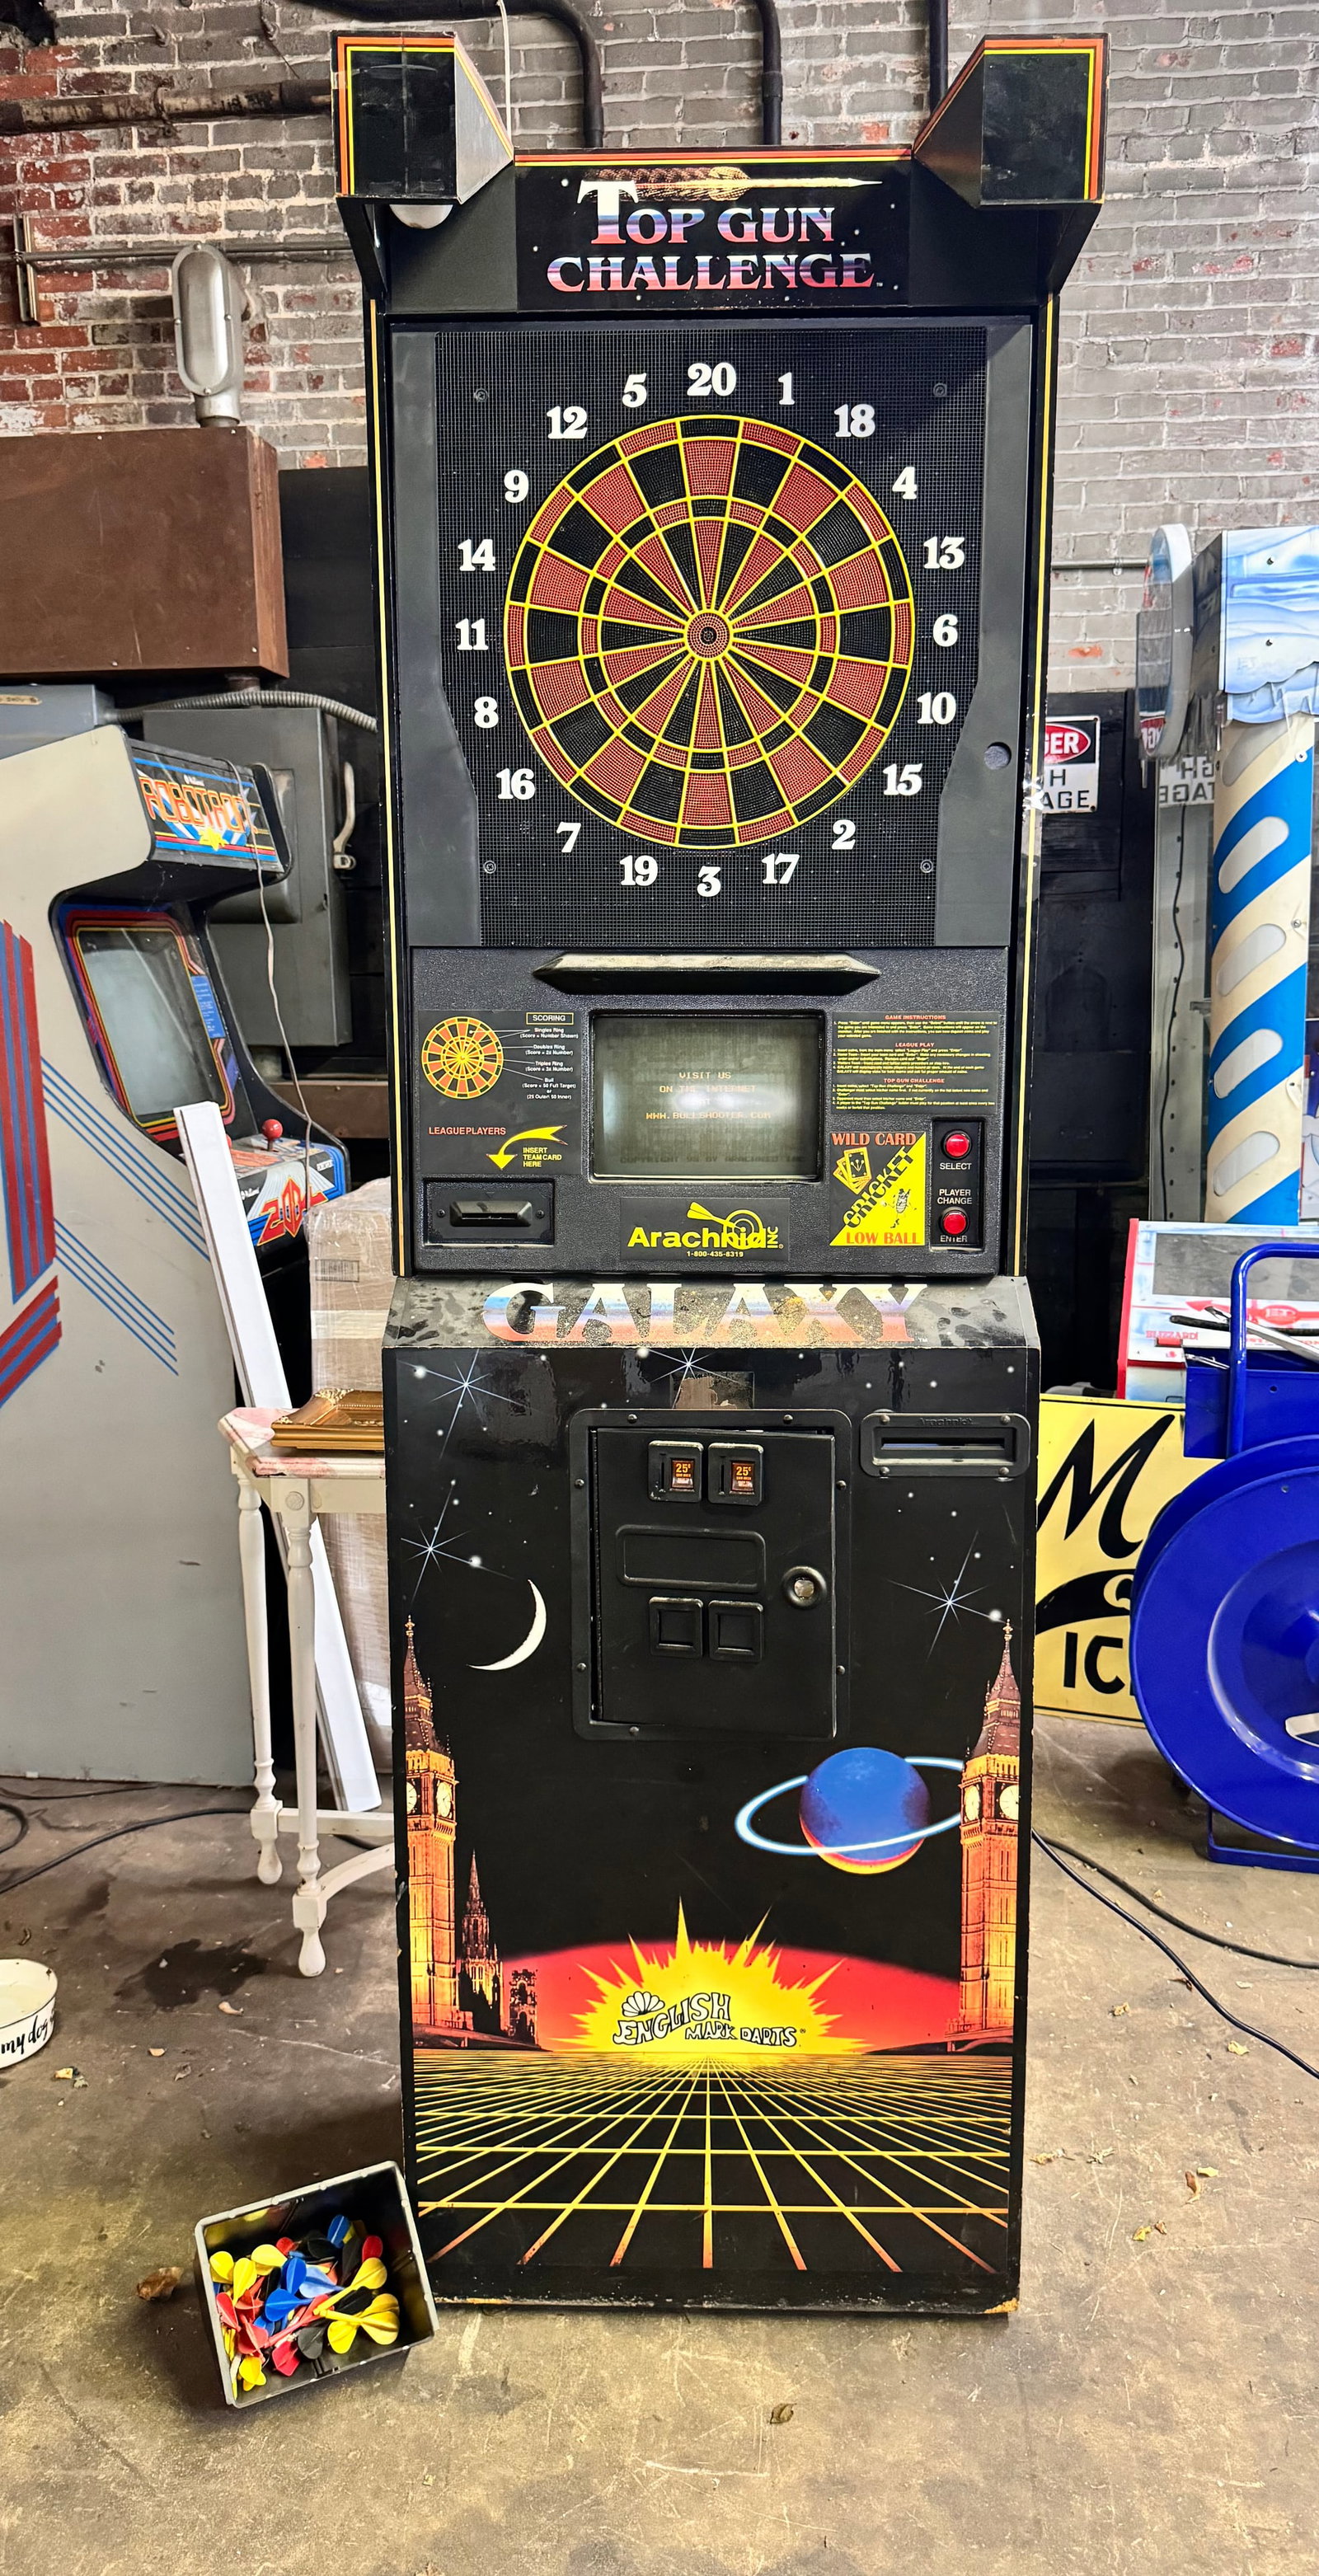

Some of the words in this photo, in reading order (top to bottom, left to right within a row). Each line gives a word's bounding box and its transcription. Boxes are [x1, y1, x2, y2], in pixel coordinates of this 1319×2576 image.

[577, 180, 705, 245] TOP
[717, 207, 834, 243] GUN
[547, 252, 875, 292] CHALLENGE
[622, 373, 646, 407] 5
[688, 363, 736, 396] 20
[779, 373, 794, 405] 1
[547, 406, 587, 439] 12
[835, 405, 875, 437] 18
[505, 470, 528, 503] 9
[893, 467, 917, 499] 4
[458, 539, 495, 570] 14
[924, 537, 965, 569] 13
[456, 619, 488, 650] 11
[933, 614, 957, 646] 6
[475, 697, 498, 728] 8
[918, 692, 955, 724] 10
[497, 768, 535, 800] 16
[884, 764, 922, 795] 15
[556, 823, 580, 852] 7
[832, 819, 855, 849] 2
[620, 856, 658, 885] 19
[697, 866, 721, 897] 3
[763, 853, 799, 884] 17
[429, 1127, 464, 1135] LEAGUE
[467, 1127, 506, 1135] PLAYERS
[832, 1133, 870, 1146] WILD
[875, 1133, 916, 1146] CARD
[843, 1146, 913, 1228] CRICKET
[627, 1227, 766, 1249] Arachnid
[767, 1226, 779, 1249] INC
[846, 1232, 879, 1244] LOW
[884, 1232, 918, 1244] BALL
[481, 1282, 928, 1343] GALAXY
[1063, 1631, 1135, 1696] IC
[613, 1992, 731, 2046] ENGLISH
[685, 2020, 738, 2040] MARK
[740, 2026, 797, 2048] DARTS
